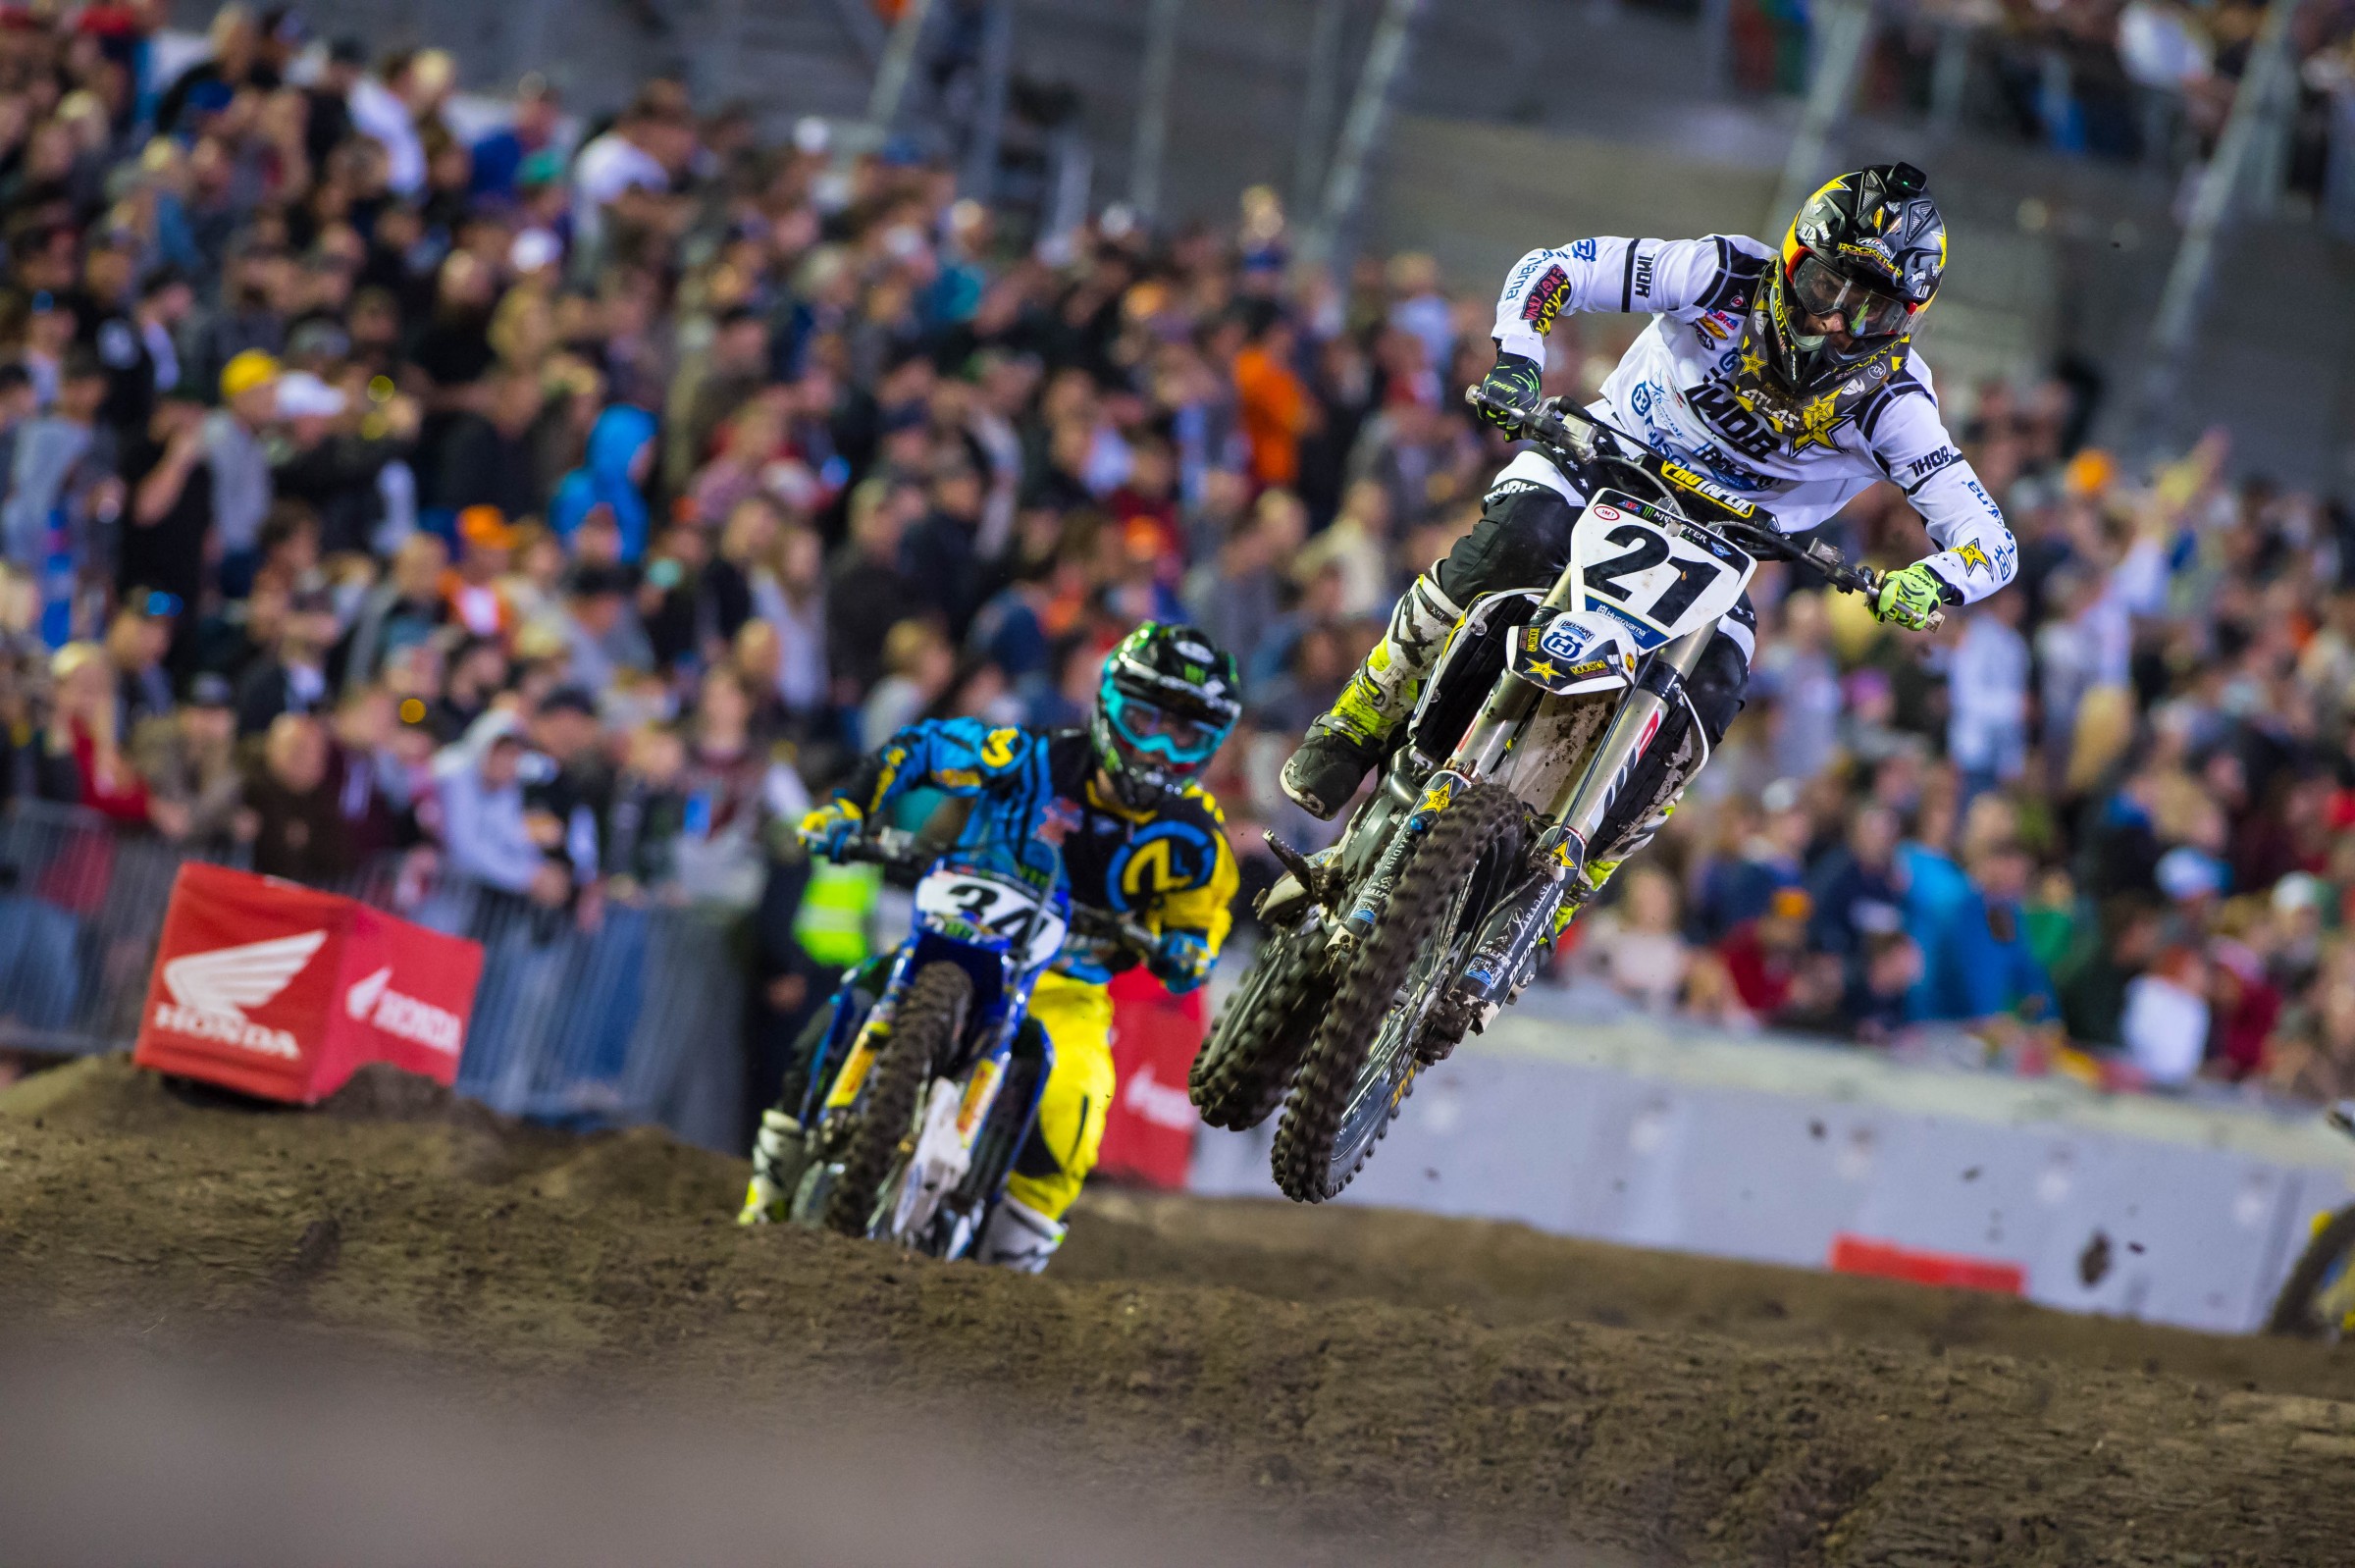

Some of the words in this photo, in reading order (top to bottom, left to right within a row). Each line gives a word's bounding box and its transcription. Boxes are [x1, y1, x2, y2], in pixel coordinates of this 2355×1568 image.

[1742, 388, 1800, 429] ATLAS
[1907, 444, 1953, 478] THOR
[1653, 511, 1707, 542] MOTER
[1583, 524, 1722, 629] 21
[1606, 609, 1648, 638] Husqvarna
[1570, 659, 1609, 676] ROCKSTAR
[1507, 887, 1565, 984] DUNLOP
[154, 1001, 302, 1060] HONDA
